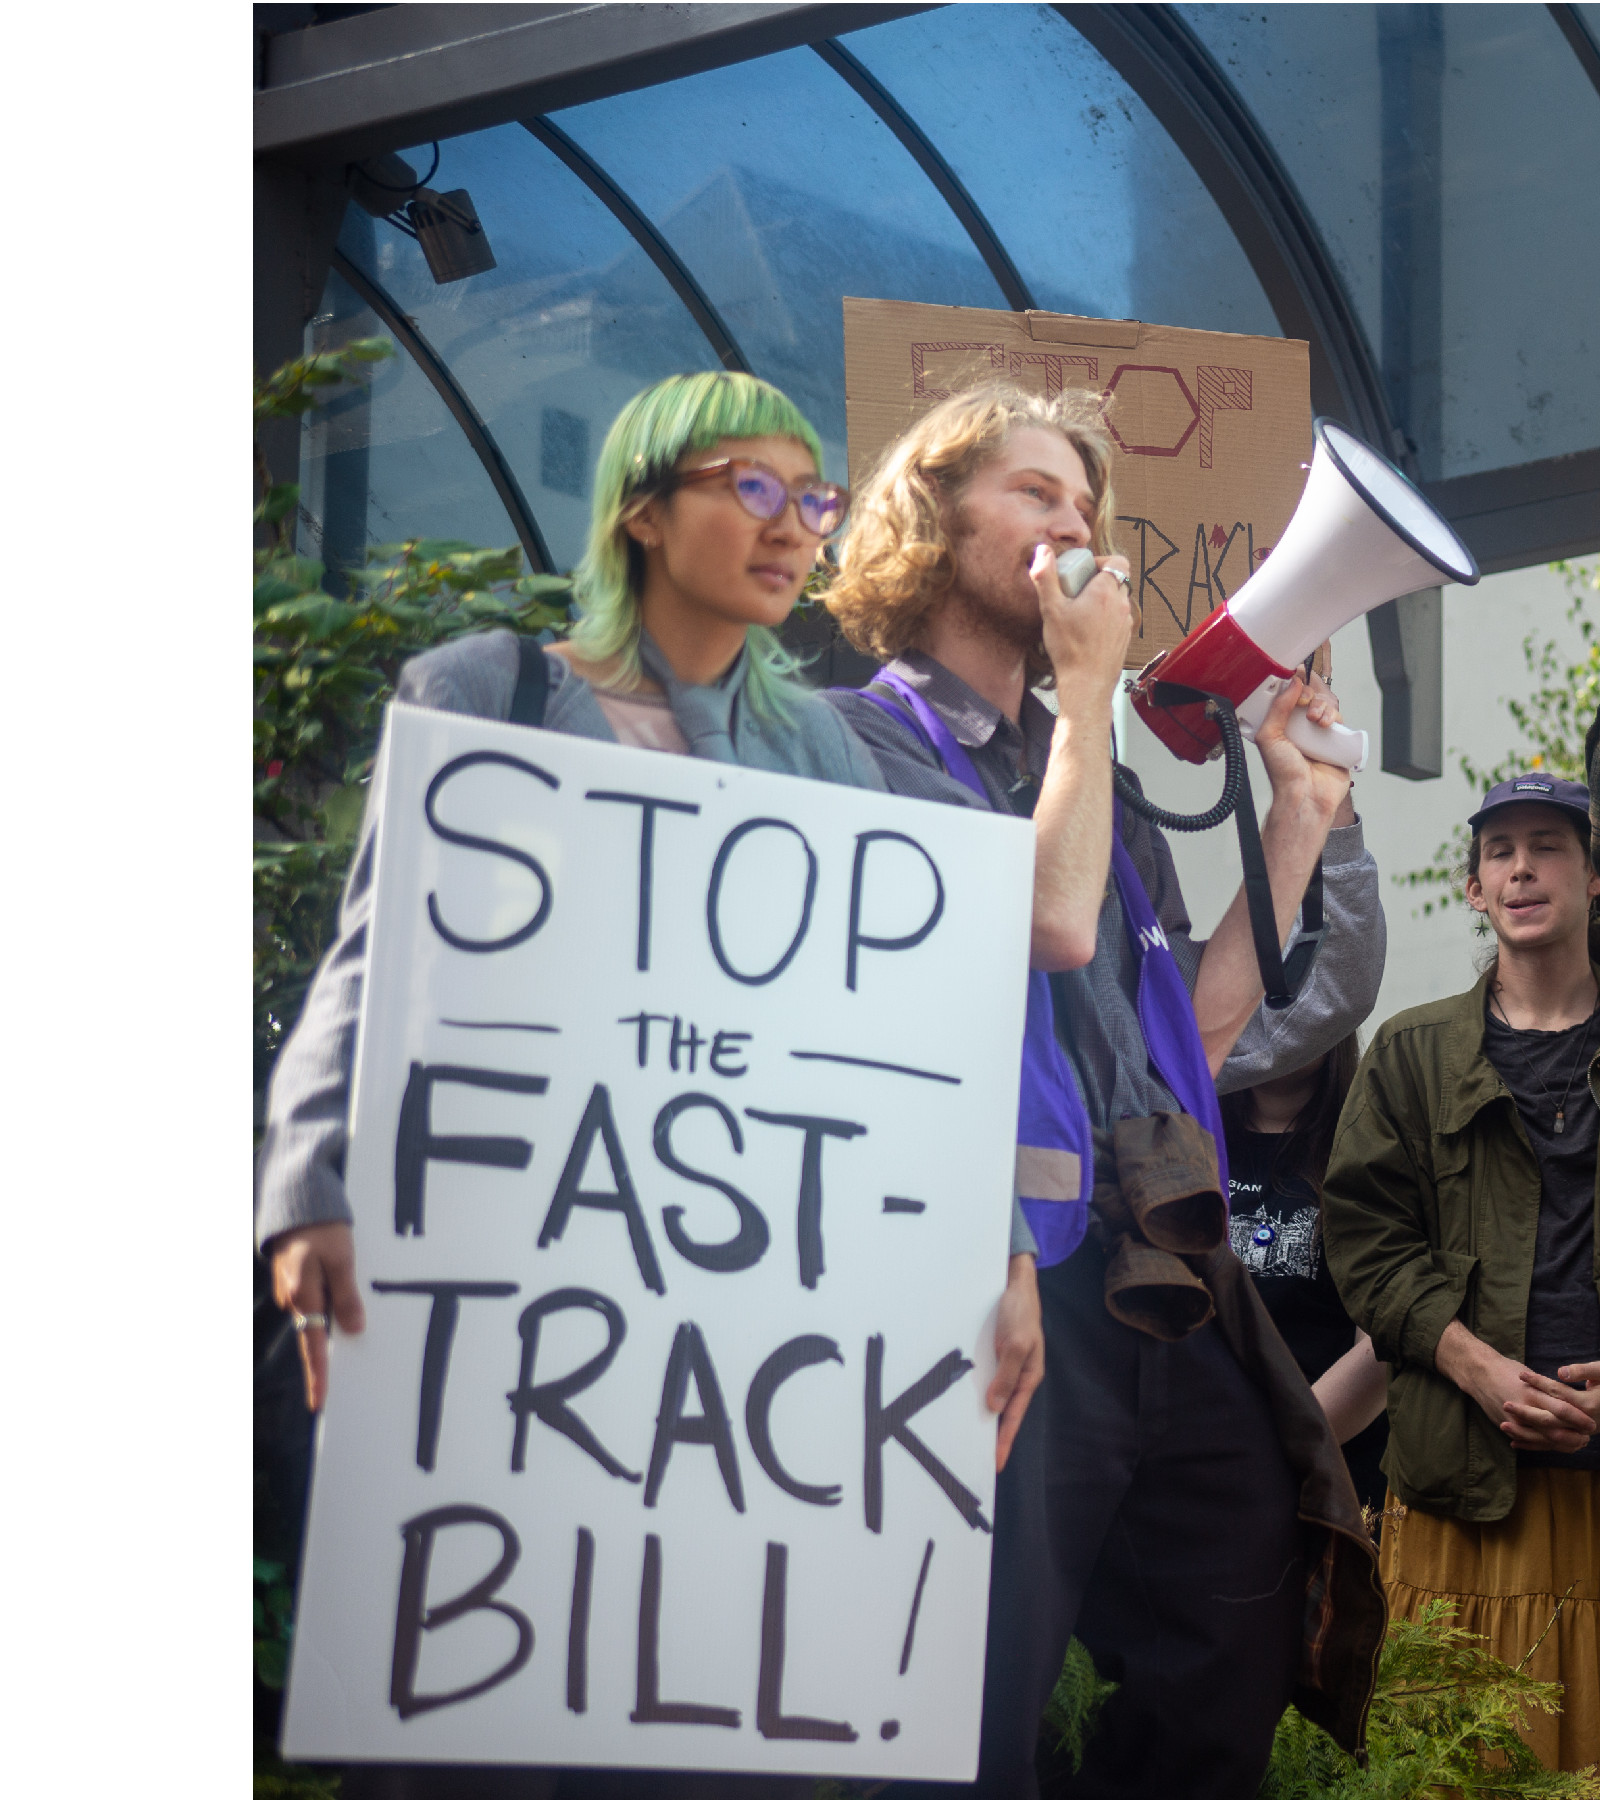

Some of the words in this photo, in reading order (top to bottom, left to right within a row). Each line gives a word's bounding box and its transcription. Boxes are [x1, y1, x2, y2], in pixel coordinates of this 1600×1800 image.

[425, 751, 945, 991] STOP
[617, 1012, 752, 1077] THE
[394, 1062, 926, 1296] FAST-
[1228, 1179, 1263, 1192] GIAN
[372, 1280, 993, 1534] TRACK
[387, 1504, 935, 1744] BILL!
